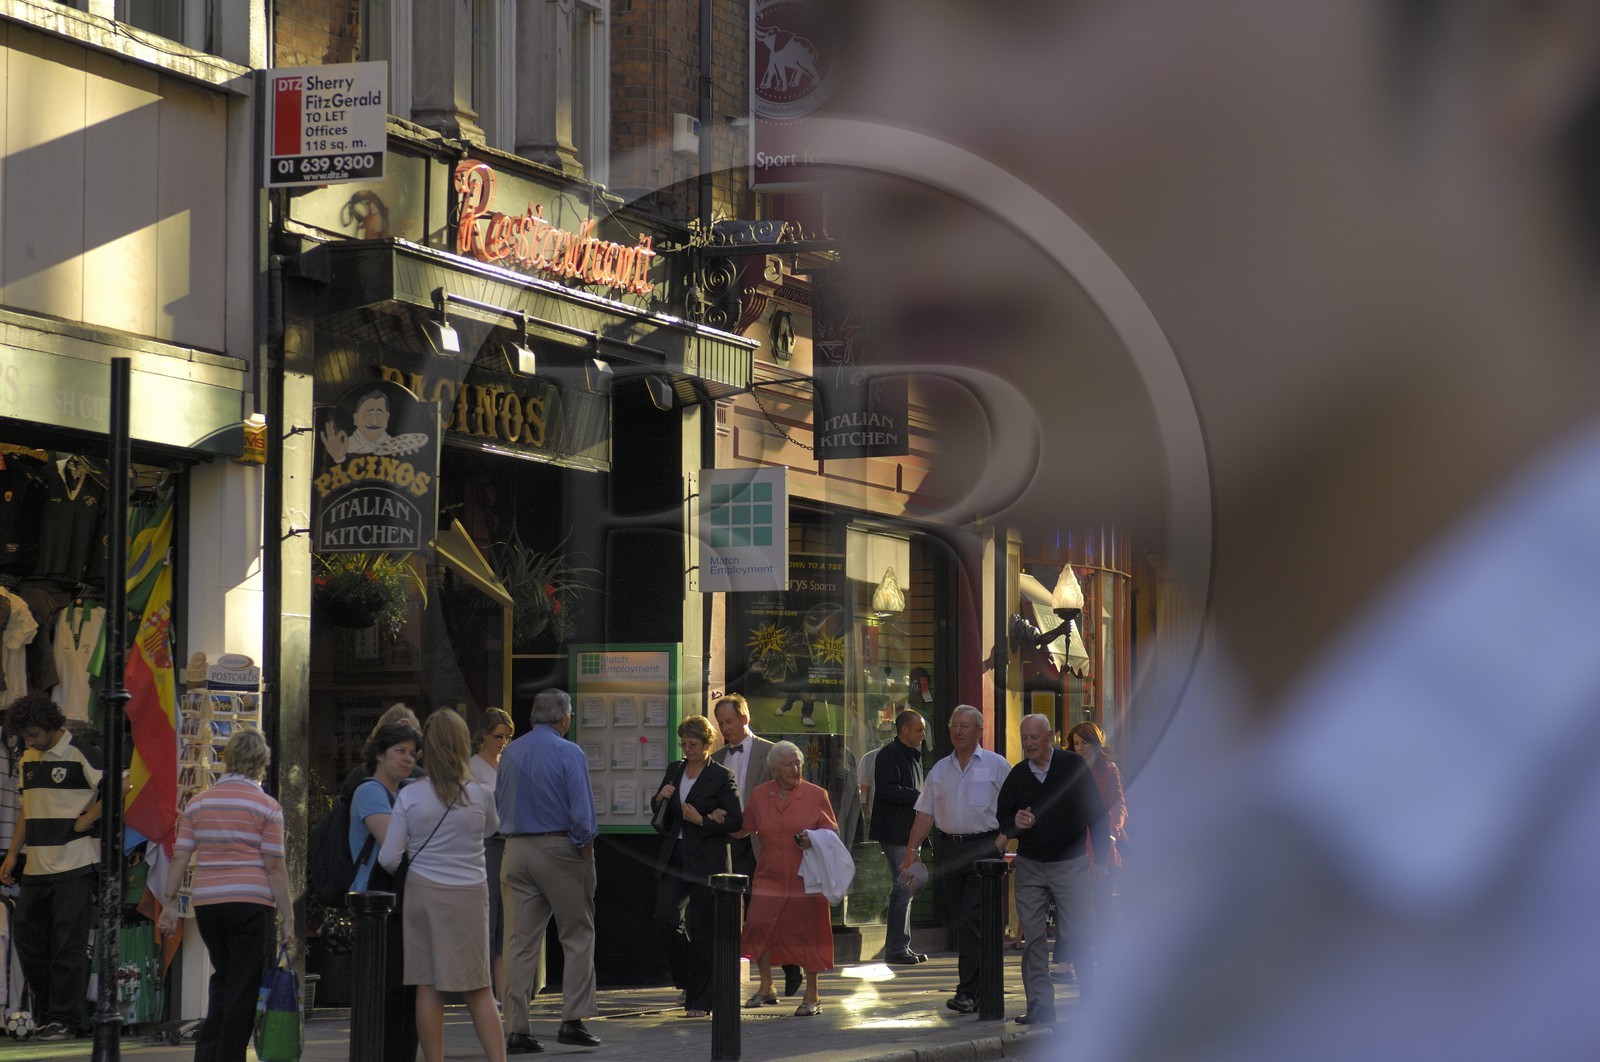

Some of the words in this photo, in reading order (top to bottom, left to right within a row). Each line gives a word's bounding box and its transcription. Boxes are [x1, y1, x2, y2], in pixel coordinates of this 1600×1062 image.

[278, 79, 302, 92] DTZ
[306, 75, 354, 92] Sherry
[305, 90, 381, 110] FitzGerald
[305, 113, 321, 123] TO
[325, 111, 346, 122] LET
[305, 125, 348, 138] Offices
[305, 140, 327, 151] 118
[330, 141, 348, 151] sq.
[352, 139, 367, 148] m.
[278, 160, 294, 173] 01
[300, 158, 330, 172] 639
[334, 155, 374, 170] 9300
[756, 151, 797, 170] Sport
[303, 171, 349, 181] www.dtz.ie
[455, 159, 657, 294] Restaurant
[26, 384, 76, 417] IRSH
[80, 394, 111, 421] GIF
[824, 412, 894, 431] ITALIAN
[820, 431, 898, 447] KITCHEN
[313, 455, 431, 498] PACINOS
[330, 496, 411, 524] ITALIAN
[324, 525, 415, 546] KITCHEN
[710, 556, 740, 565] Match
[710, 565, 774, 576] Employment
[810, 581, 837, 592] Sports
[600, 655, 628, 664] Match
[600, 664, 659, 675] Employment
[212, 672, 259, 682] POSTCARDS
